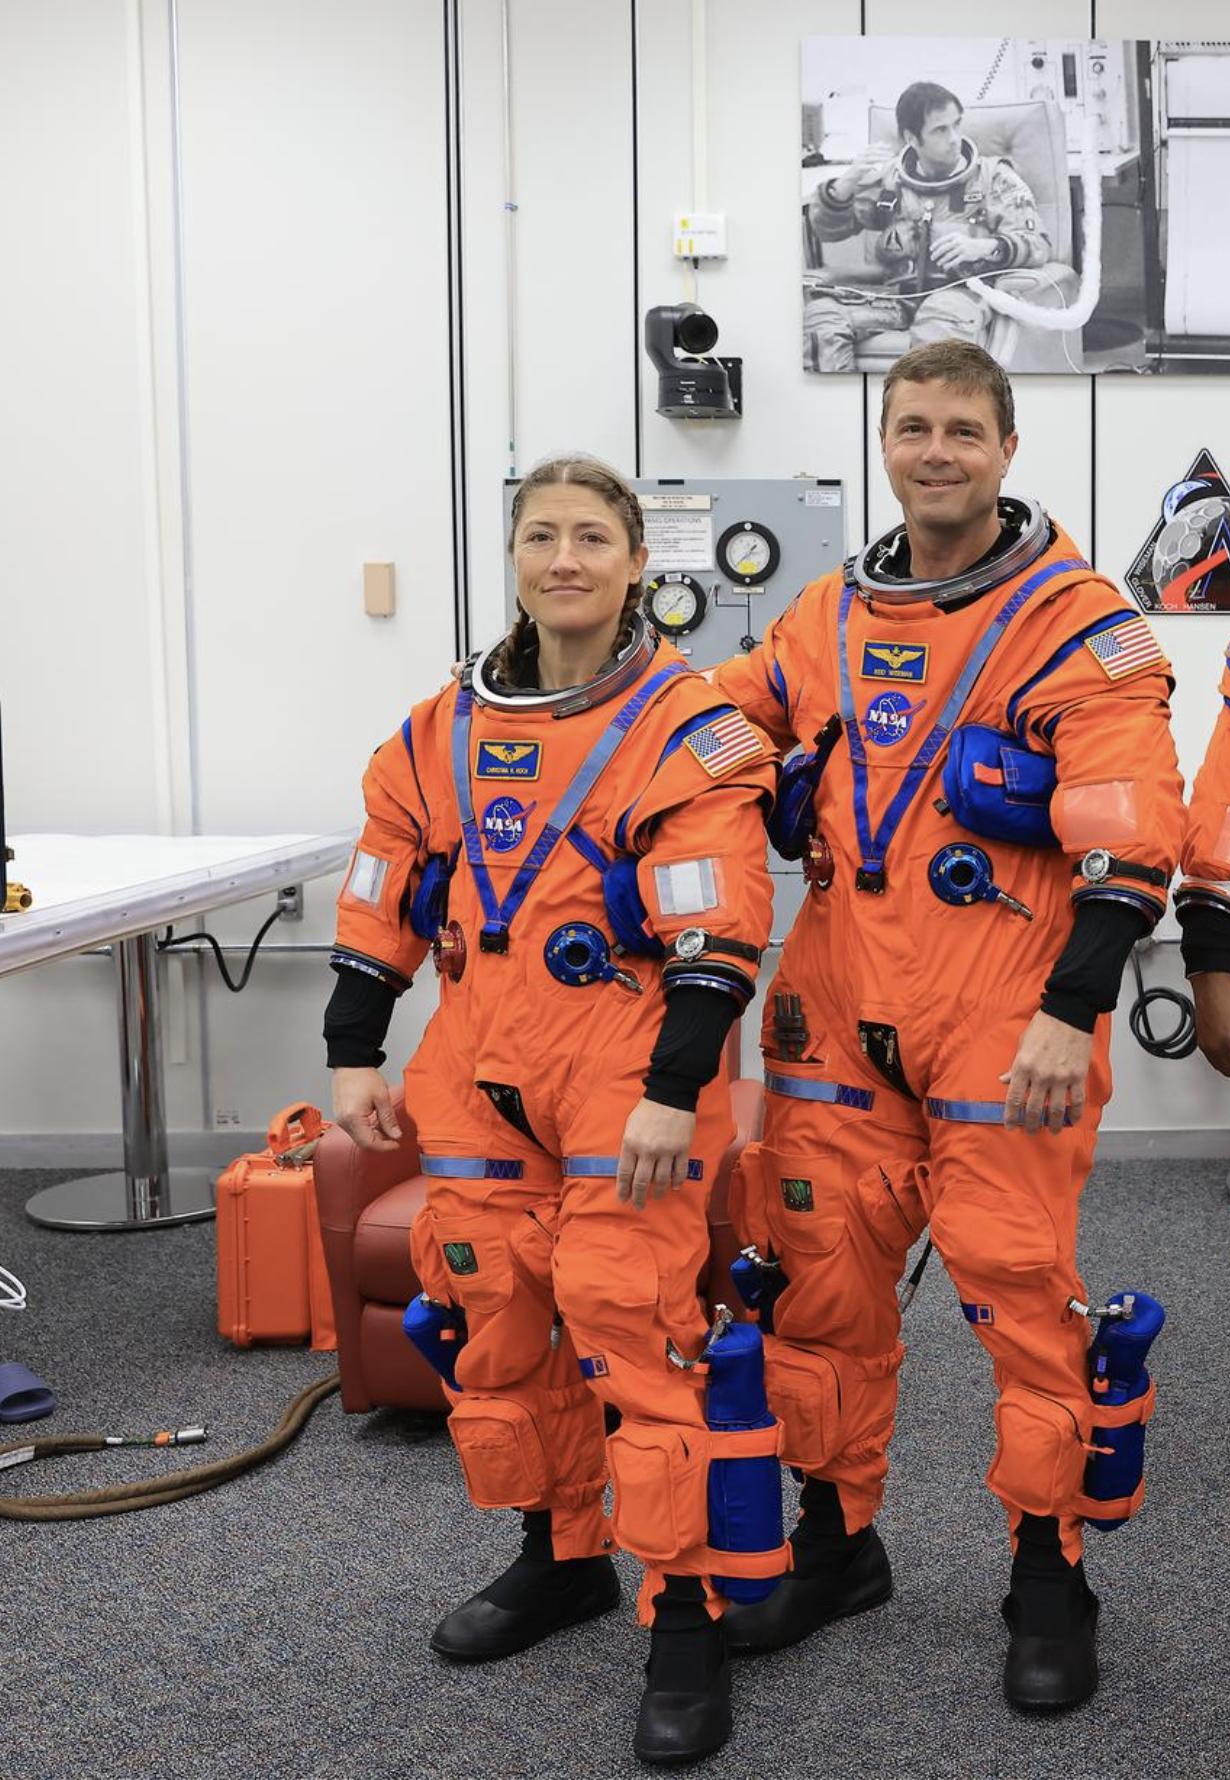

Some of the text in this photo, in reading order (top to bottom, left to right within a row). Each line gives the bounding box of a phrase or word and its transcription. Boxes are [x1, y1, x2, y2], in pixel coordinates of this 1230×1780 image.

[1133, 541, 1157, 576] WISEMAN
[1131, 577, 1153, 608] GLOVER
[867, 709, 907, 728] NASA
[484, 816, 523, 832] NASA
